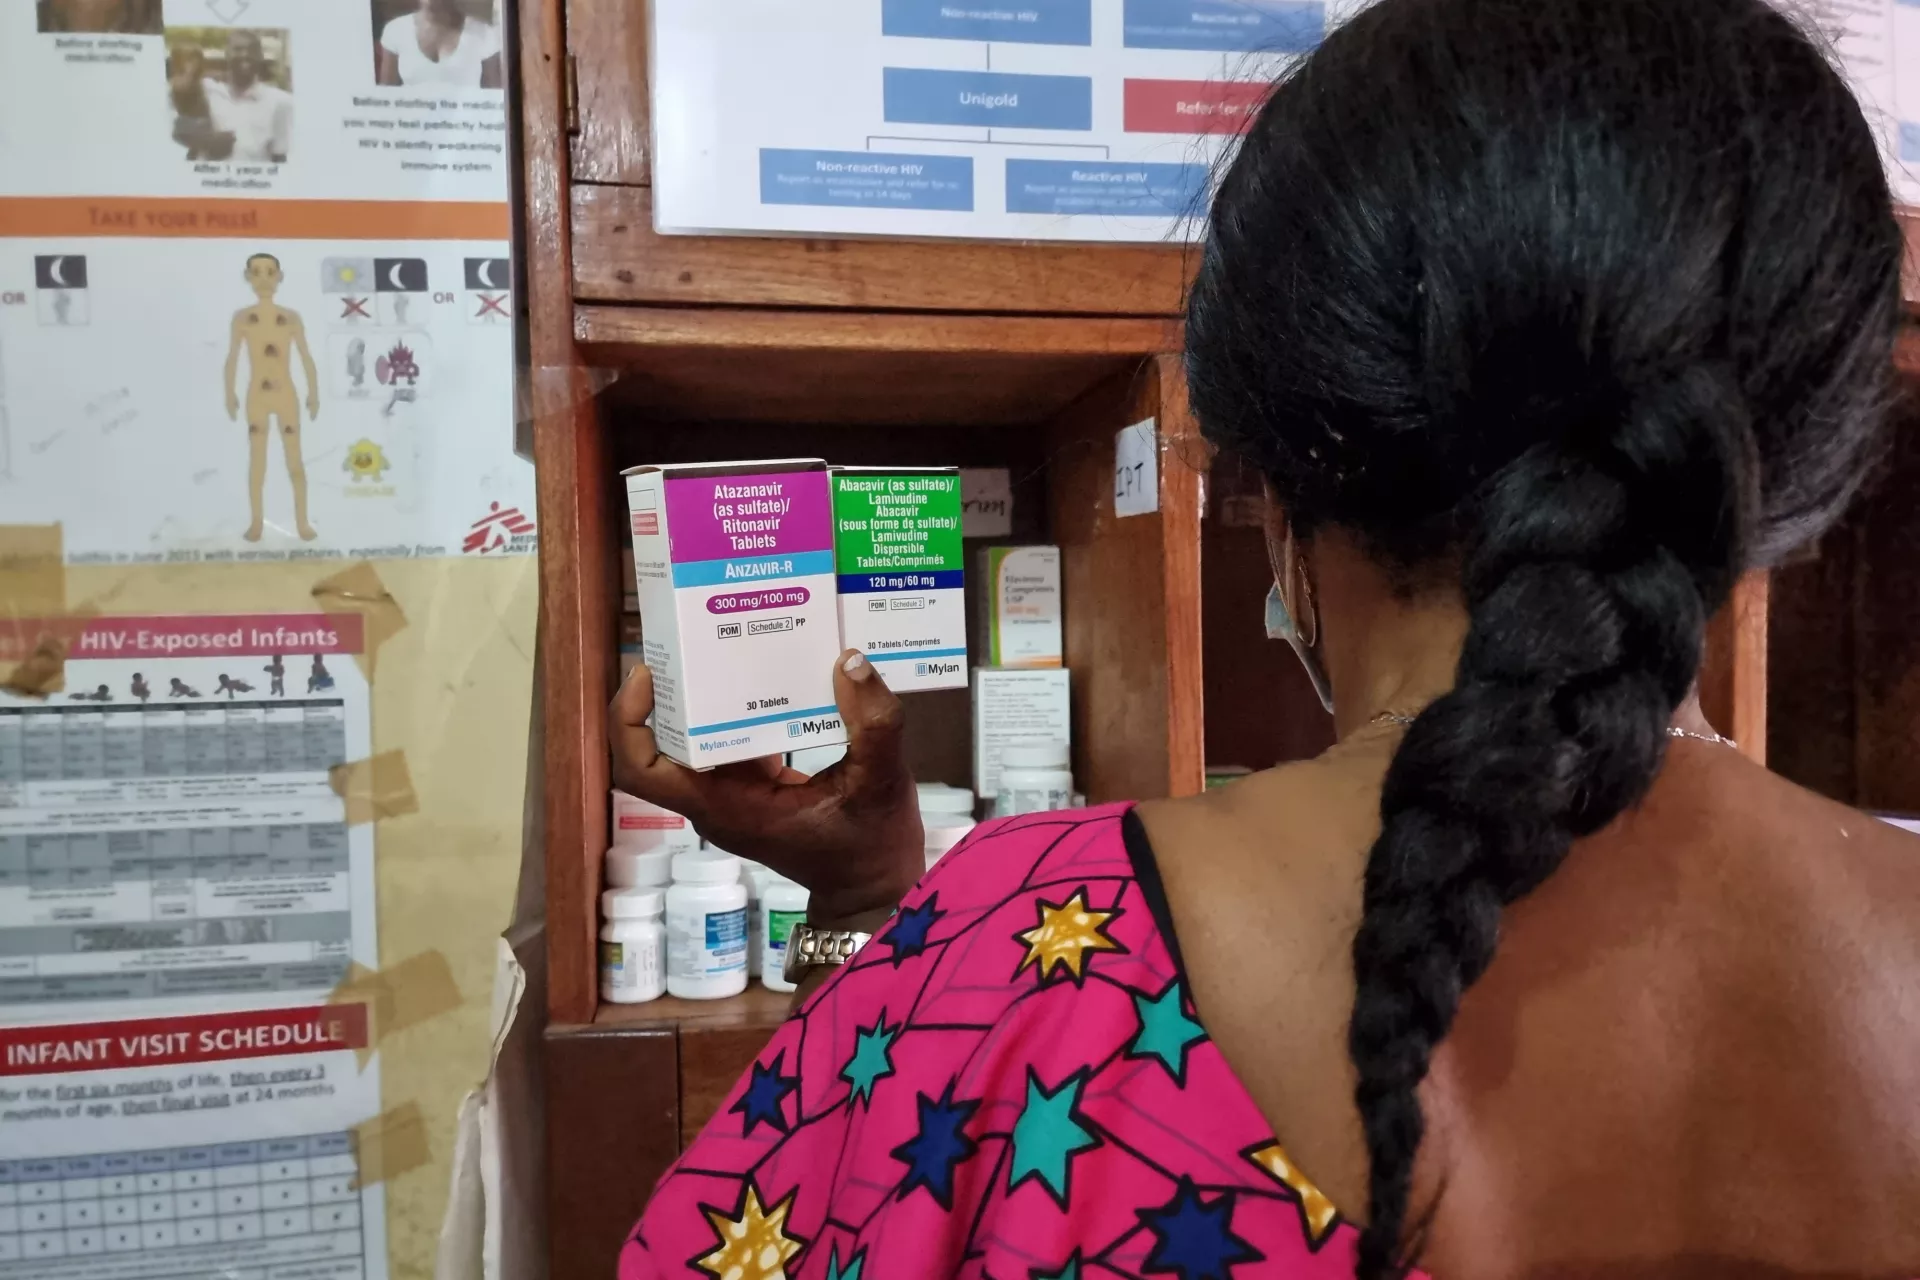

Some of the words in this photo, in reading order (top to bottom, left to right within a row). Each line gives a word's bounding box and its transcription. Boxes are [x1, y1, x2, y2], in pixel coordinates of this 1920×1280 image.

[941, 7, 1014, 22] Non-reactive
[1017, 11, 1039, 23] HIV
[960, 92, 1018, 108] Unigold
[816, 161, 898, 174] Non-reactive
[901, 165, 923, 175] HIV
[1071, 170, 1123, 182] Reactive
[1126, 172, 1148, 183] HIV
[2, 292, 26, 305] OR
[433, 292, 455, 304] OR
[840, 479, 884, 491] Abacavir
[888, 479, 905, 494] (as
[909, 479, 954, 493] sulfate)/
[1115, 462, 1144, 498] IPT
[714, 482, 782, 499] Atazanavir
[869, 493, 928, 505] Lamivudine
[713, 503, 734, 520] (as
[737, 498, 791, 516] sulfate)/
[876, 505, 919, 517] Abacavir
[723, 517, 781, 534] Ritonavir
[840, 519, 867, 532] (sous
[870, 518, 899, 530] forme
[902, 518, 914, 529] de
[917, 517, 958, 531] sulfate)/
[730, 535, 776, 550] Tablets
[871, 531, 929, 542] Lamivudine
[874, 543, 925, 556] Dispersible
[857, 554, 945, 568] Tablets/Comprimés
[725, 560, 793, 579] ANZAVIR-R
[869, 577, 886, 588] 120
[889, 576, 919, 588] mg/60
[921, 577, 935, 587] mg
[715, 597, 736, 609] 300
[740, 593, 783, 608] mg/100
[786, 592, 804, 603] mg
[893, 600, 918, 608] Schedule
[720, 626, 738, 636] POM
[750, 621, 784, 632] Schedule
[785, 620, 790, 629] 2
[795, 618, 806, 626] PP
[81, 629, 242, 652] HIV-Exposed
[251, 627, 338, 647] Infants
[868, 642, 876, 650] 30
[878, 638, 941, 649] Tablets/Comprimés
[929, 663, 960, 676] Mylan
[746, 701, 757, 710] 30
[759, 697, 789, 709] Tablets
[803, 719, 840, 735] Mylan
[700, 736, 751, 751] Mylan.com
[7, 1038, 111, 1066] INFANT
[120, 1032, 190, 1058] VISIT
[199, 1020, 345, 1053] SCHEDULE
[256, 1087, 273, 1101] 24
